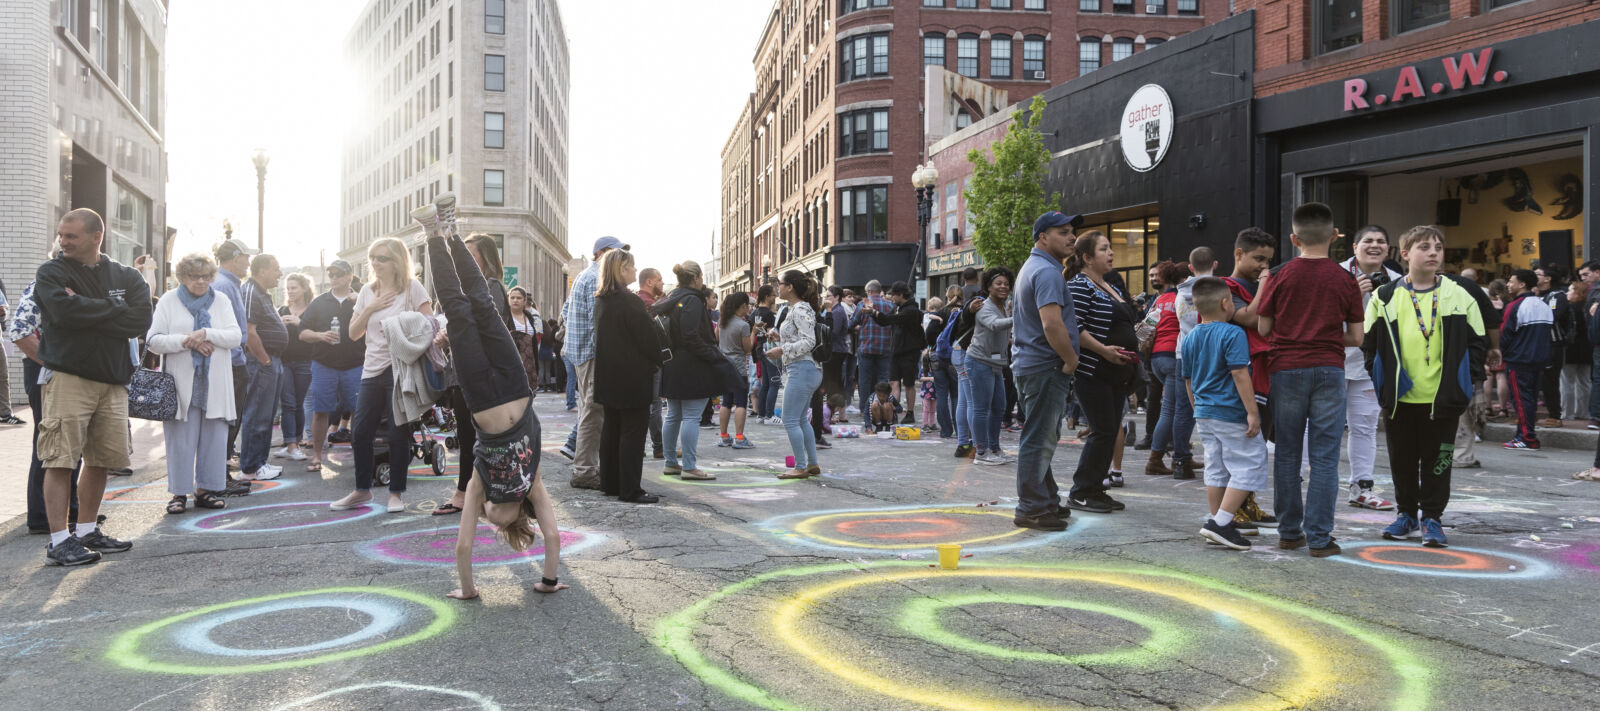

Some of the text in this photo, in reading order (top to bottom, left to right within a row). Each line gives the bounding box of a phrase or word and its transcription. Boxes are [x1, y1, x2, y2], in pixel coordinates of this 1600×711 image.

[1344, 47, 1508, 111] R.A.W.
[1128, 104, 1163, 128] gather
[963, 251, 975, 266] 18K
